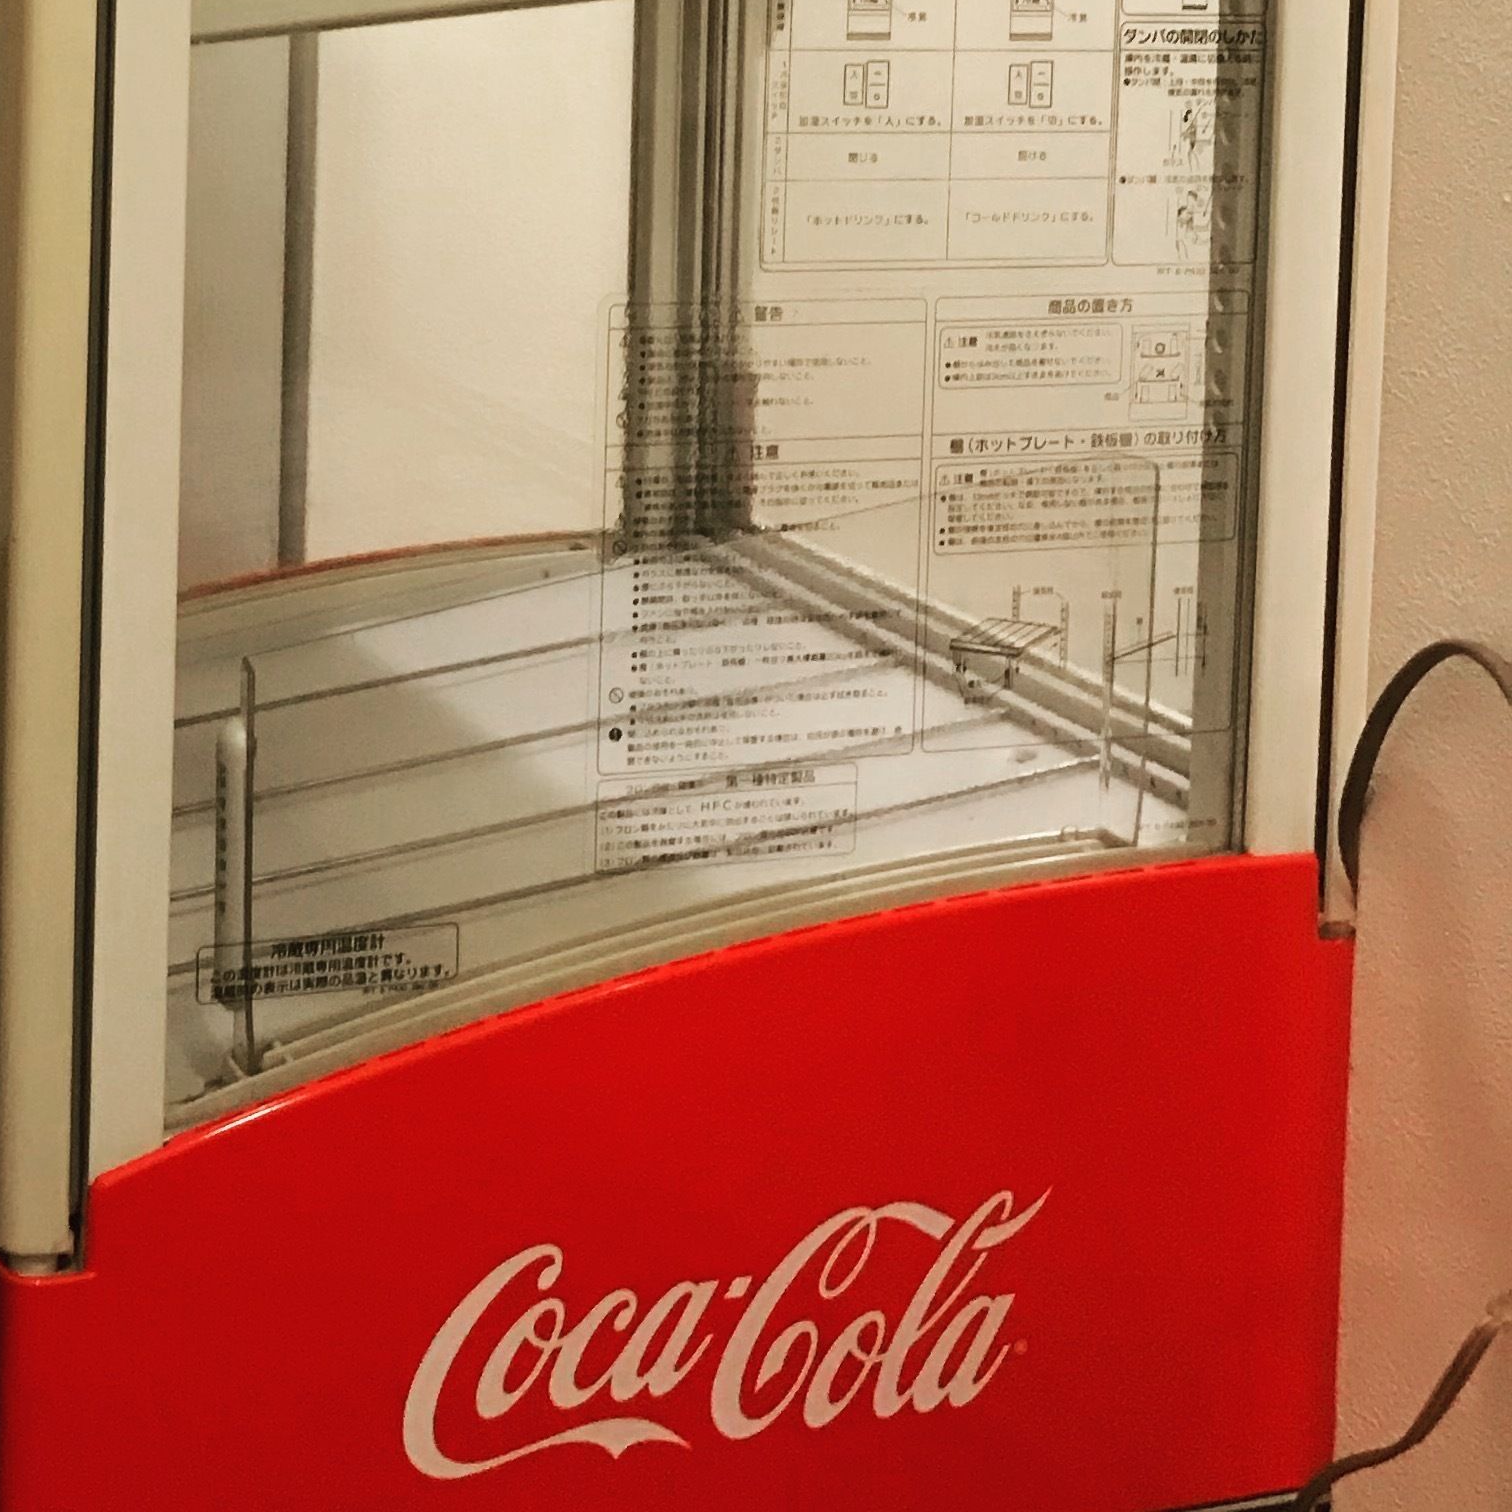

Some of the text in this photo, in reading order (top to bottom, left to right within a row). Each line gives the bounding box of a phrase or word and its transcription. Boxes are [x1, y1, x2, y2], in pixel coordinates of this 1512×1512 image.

[754, 305, 783, 322] 警告
[1047, 297, 1135, 315] 商品の置き方
[270, 933, 385, 959] 冷蔵専用温度計
[402, 1184, 1054, 1481] Coca-Cola
